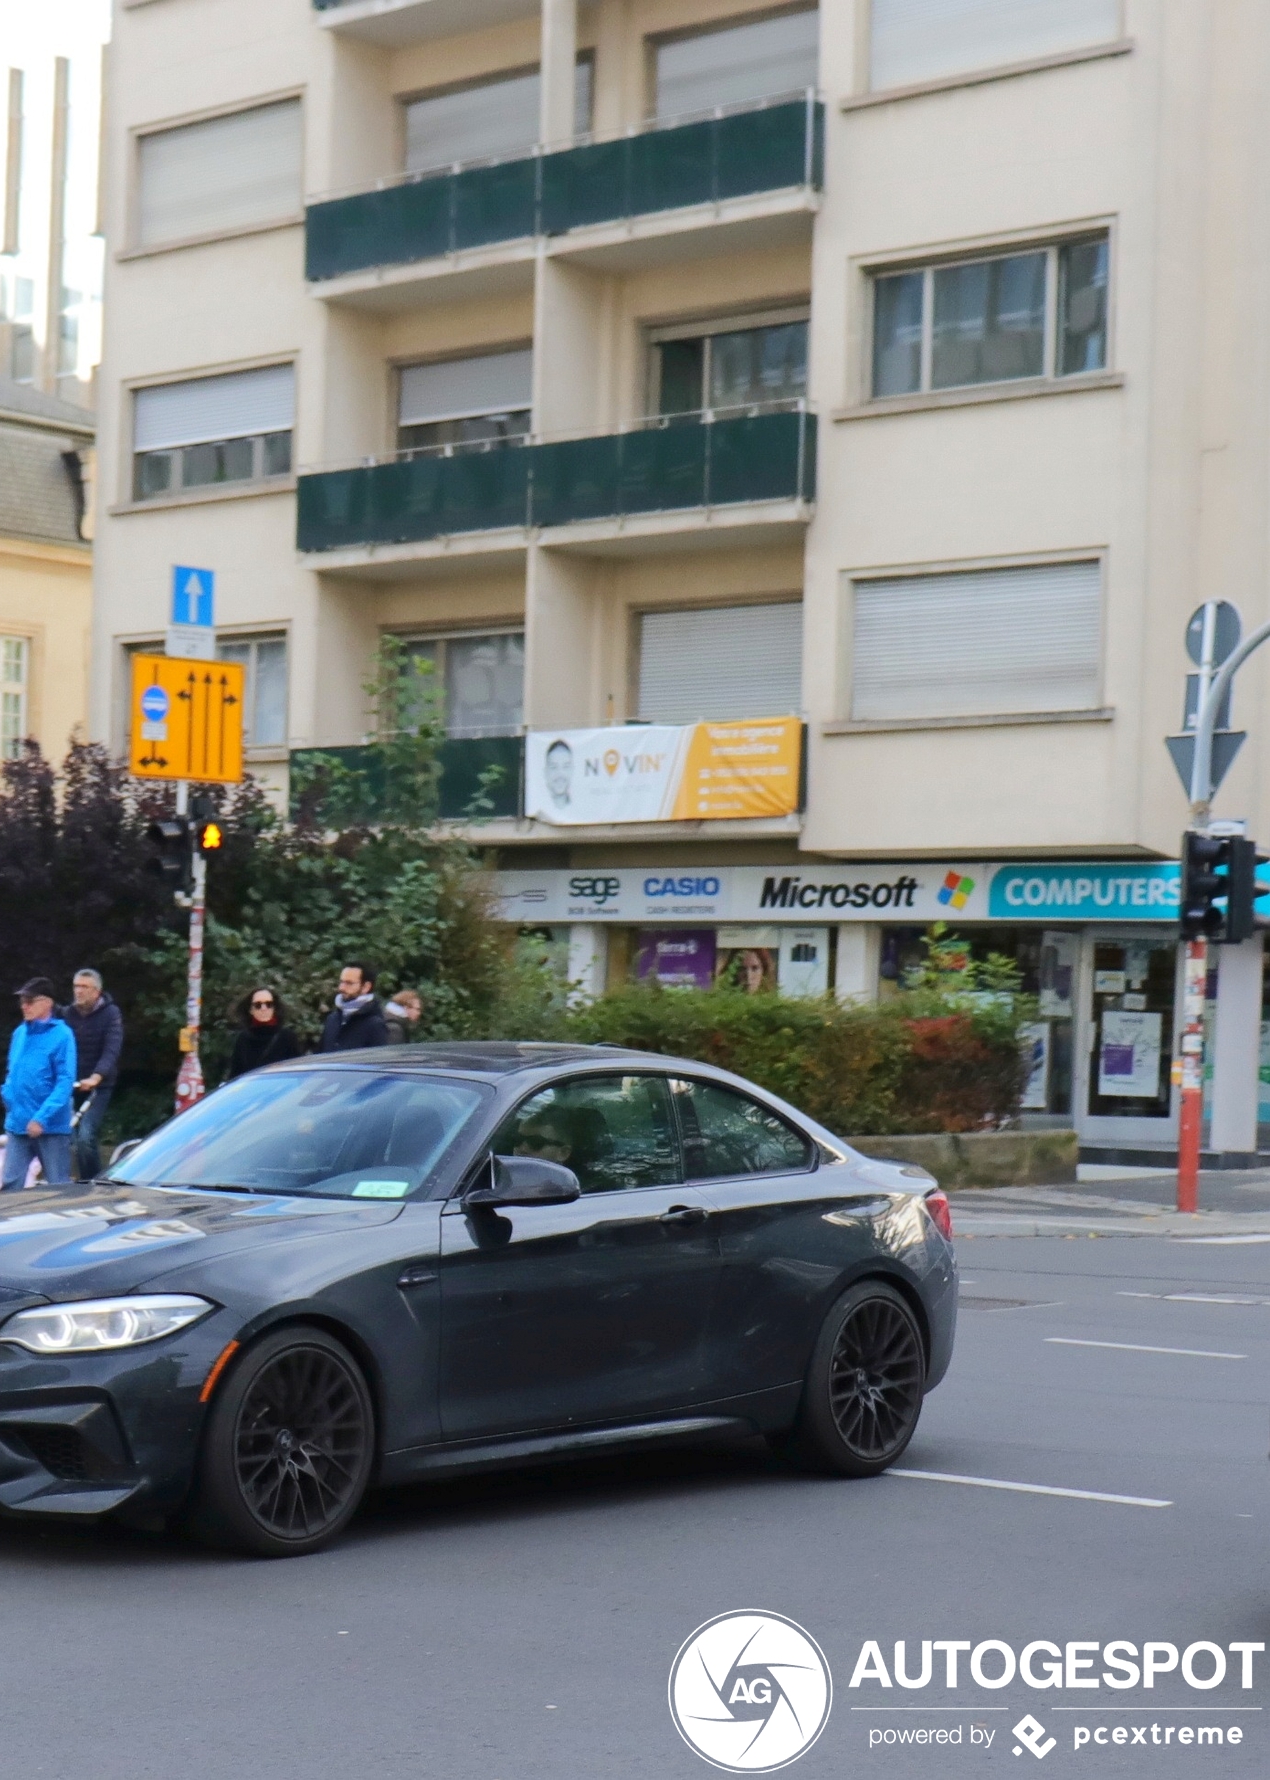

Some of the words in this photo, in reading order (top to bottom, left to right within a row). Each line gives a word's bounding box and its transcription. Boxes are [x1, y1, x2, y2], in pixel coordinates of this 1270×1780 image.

[569, 877, 620, 904] sage
[644, 876, 720, 897] CASIO
[759, 876, 918, 908] Microsoft
[1005, 877, 1181, 906] COMPUTERS
